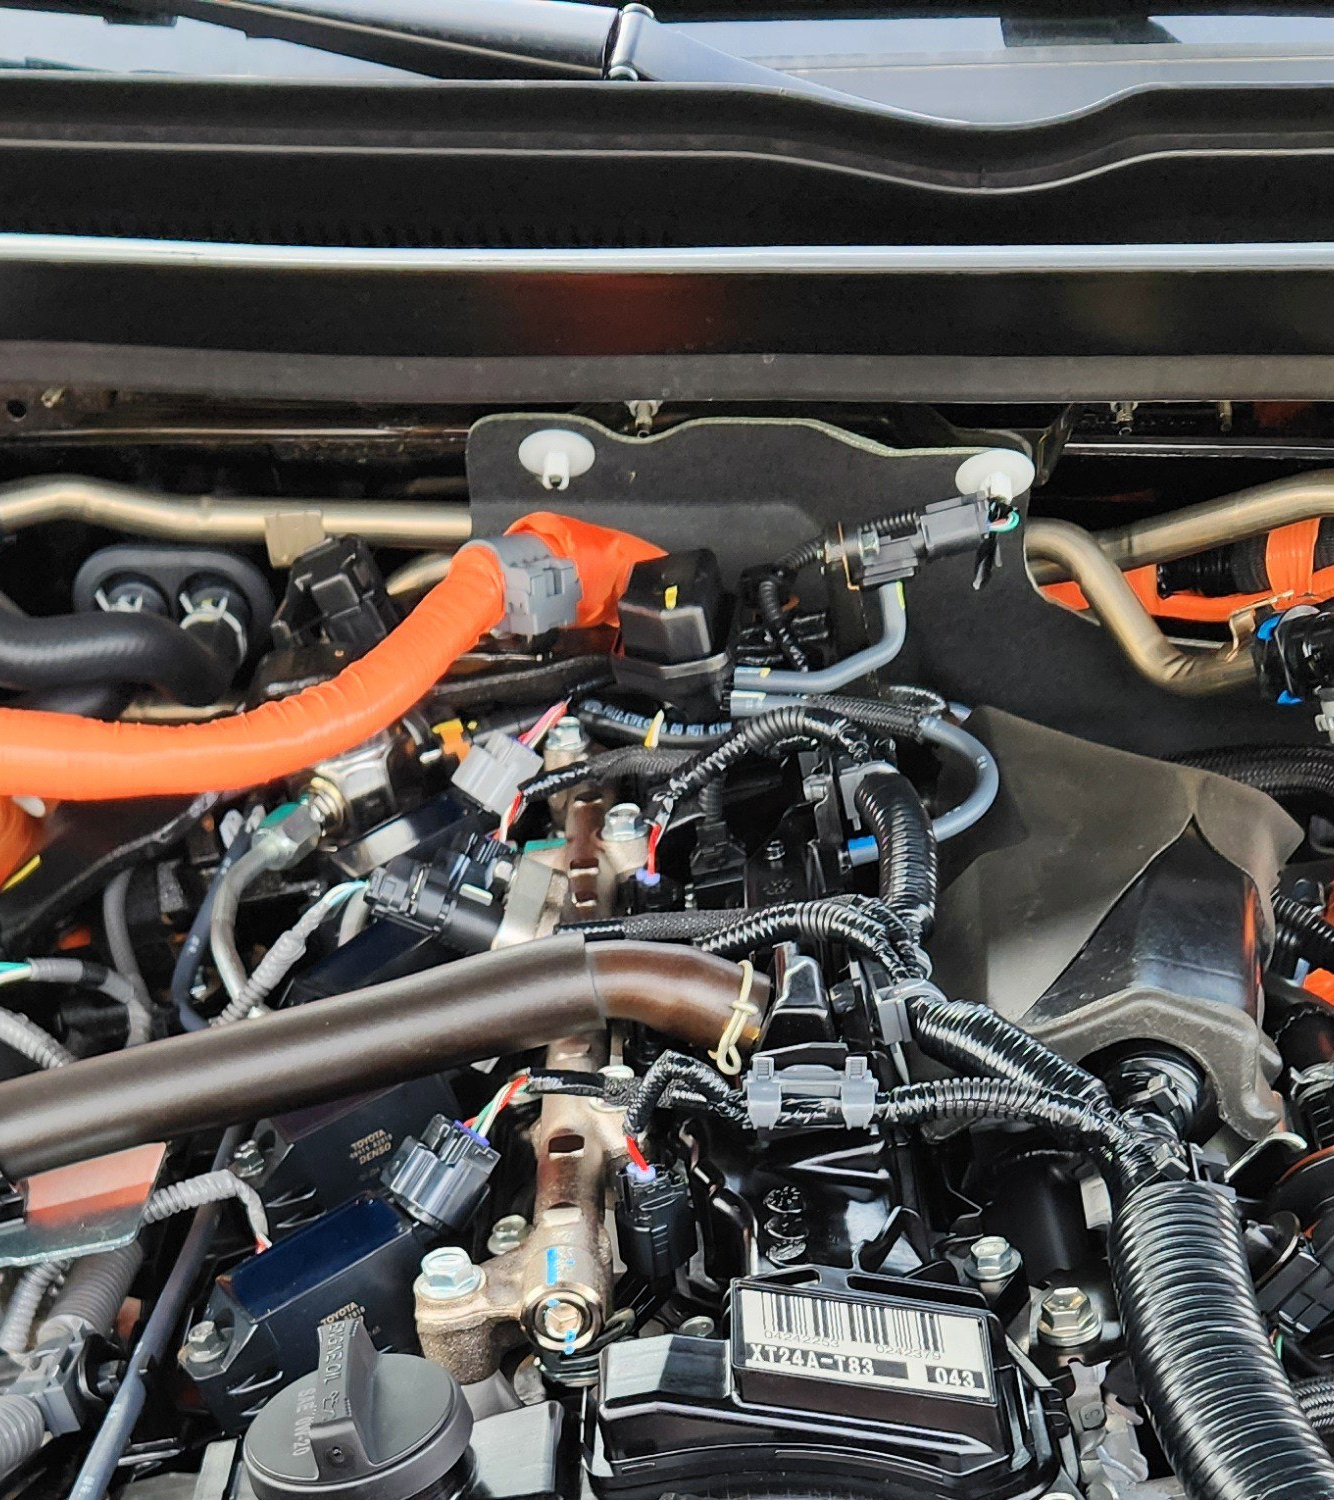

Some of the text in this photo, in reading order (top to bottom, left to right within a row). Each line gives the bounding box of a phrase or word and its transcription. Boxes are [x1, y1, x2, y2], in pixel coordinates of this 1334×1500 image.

[351, 1129, 387, 1150] TOYOTA
[358, 1142, 392, 1165] DENSO
[320, 1301, 360, 1325] TOYOTA
[323, 1363, 344, 1385] OIL
[750, 1343, 976, 1388] XT24A-T83 043
